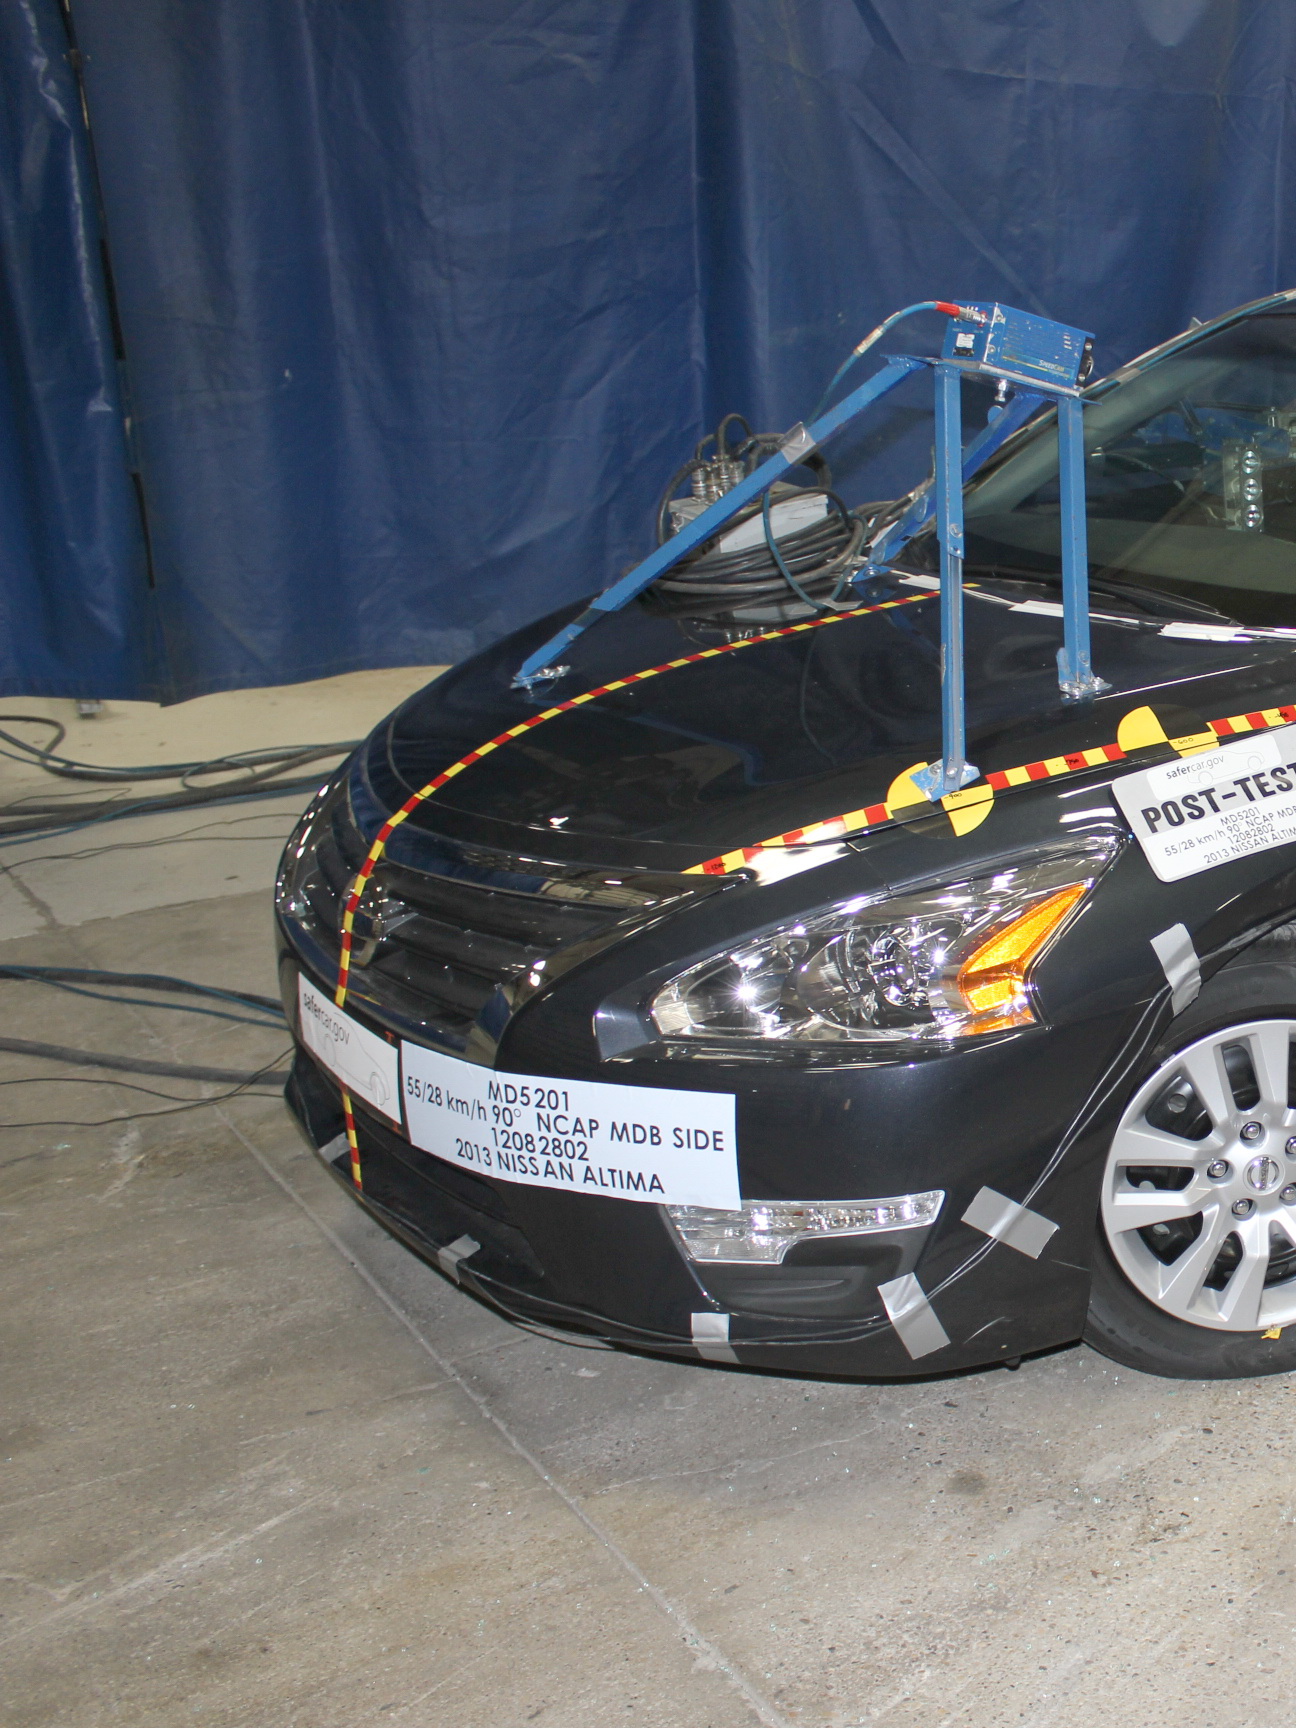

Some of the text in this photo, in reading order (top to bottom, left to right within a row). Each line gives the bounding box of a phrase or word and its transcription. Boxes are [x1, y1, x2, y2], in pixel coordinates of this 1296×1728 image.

[1166, 755, 1225, 780] safercar.gov
[1219, 806, 1261, 827] MD5201
[1164, 838, 1196, 857] 55/28
[1196, 828, 1226, 847] km/h
[1245, 812, 1274, 829] NCAP
[1203, 848, 1230, 864] 2013
[1230, 835, 1270, 855] NISSAN
[1227, 823, 1276, 845] 12082802
[303, 992, 350, 1045] safercar.gov
[488, 1080, 569, 1112] MD5201
[407, 1075, 725, 1151] 55/28 km/h 90° NCAP MDB SIDE
[491, 1127, 589, 1162] 12082802
[456, 1137, 666, 1194] 2013 NISSAN ALTIMA
